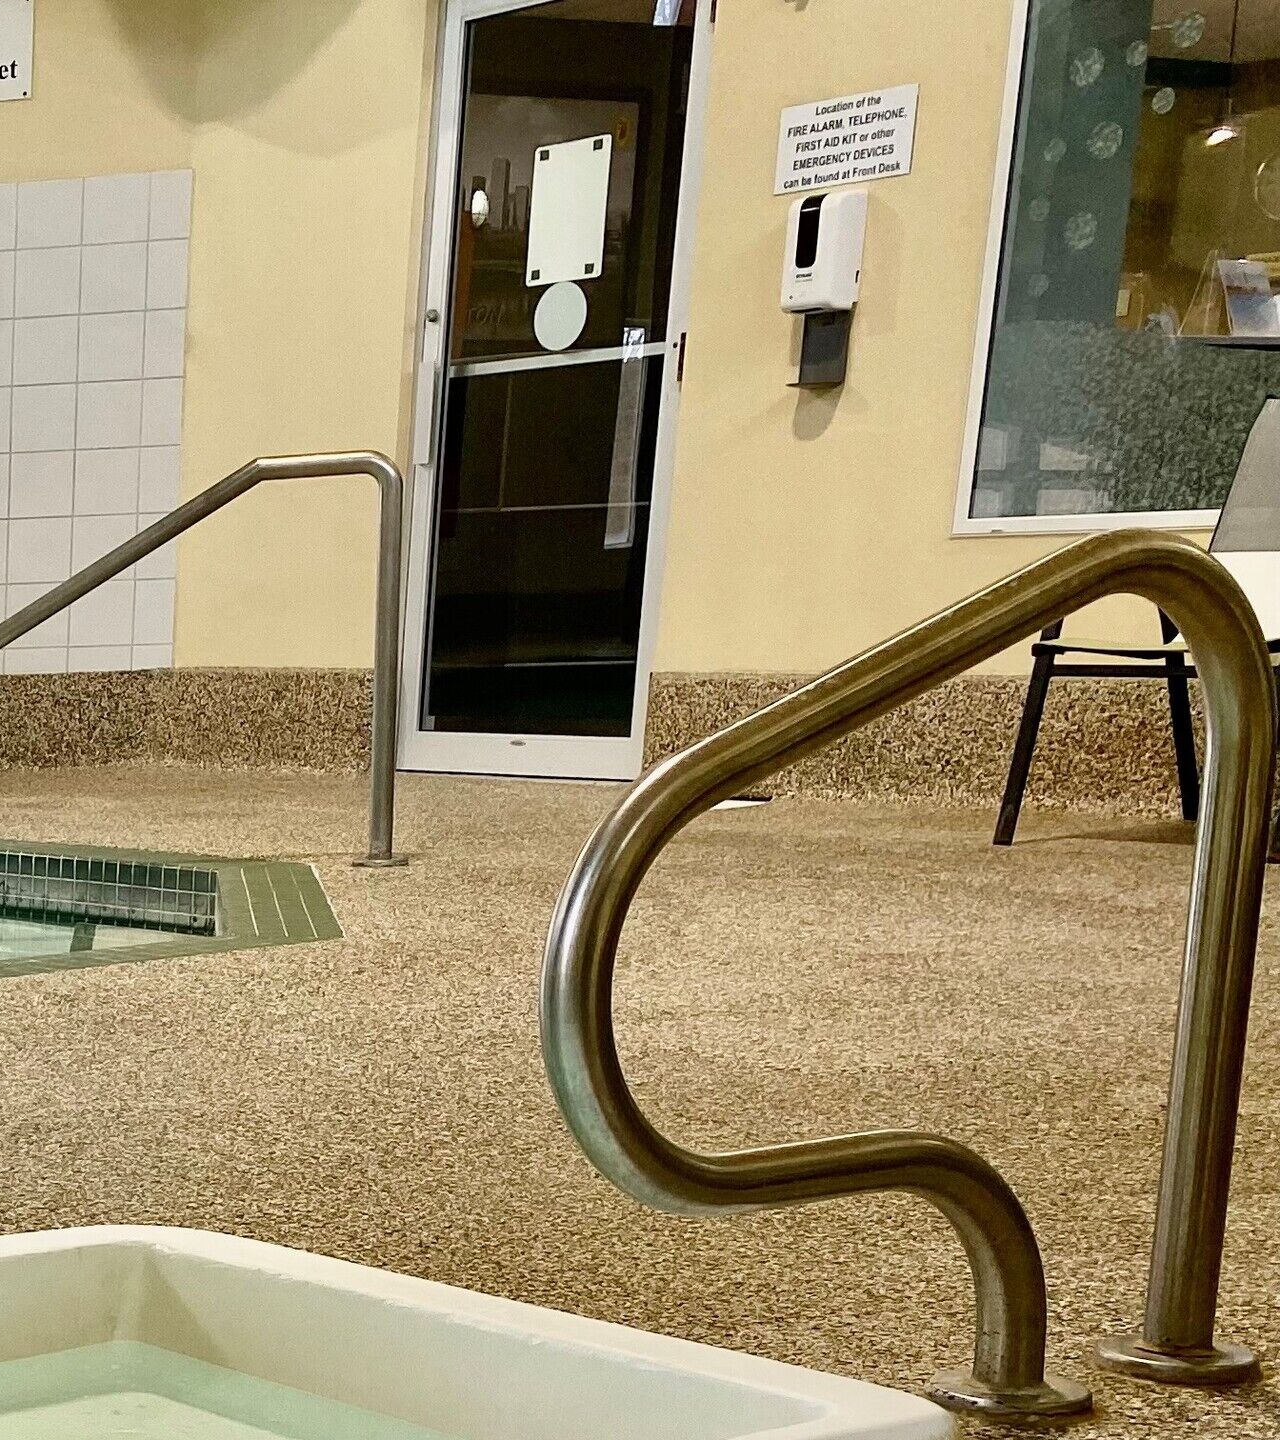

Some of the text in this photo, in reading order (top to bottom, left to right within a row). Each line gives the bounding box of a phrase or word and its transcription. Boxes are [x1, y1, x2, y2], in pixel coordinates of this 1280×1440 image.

[816, 96, 881, 115] Location of the
[787, 125, 808, 138] FIRE
[796, 128, 895, 153] FIRST AID KIT or other
[793, 144, 894, 170] EMERGENCY DEVICES
[783, 161, 900, 189] can be found at Front Desk
